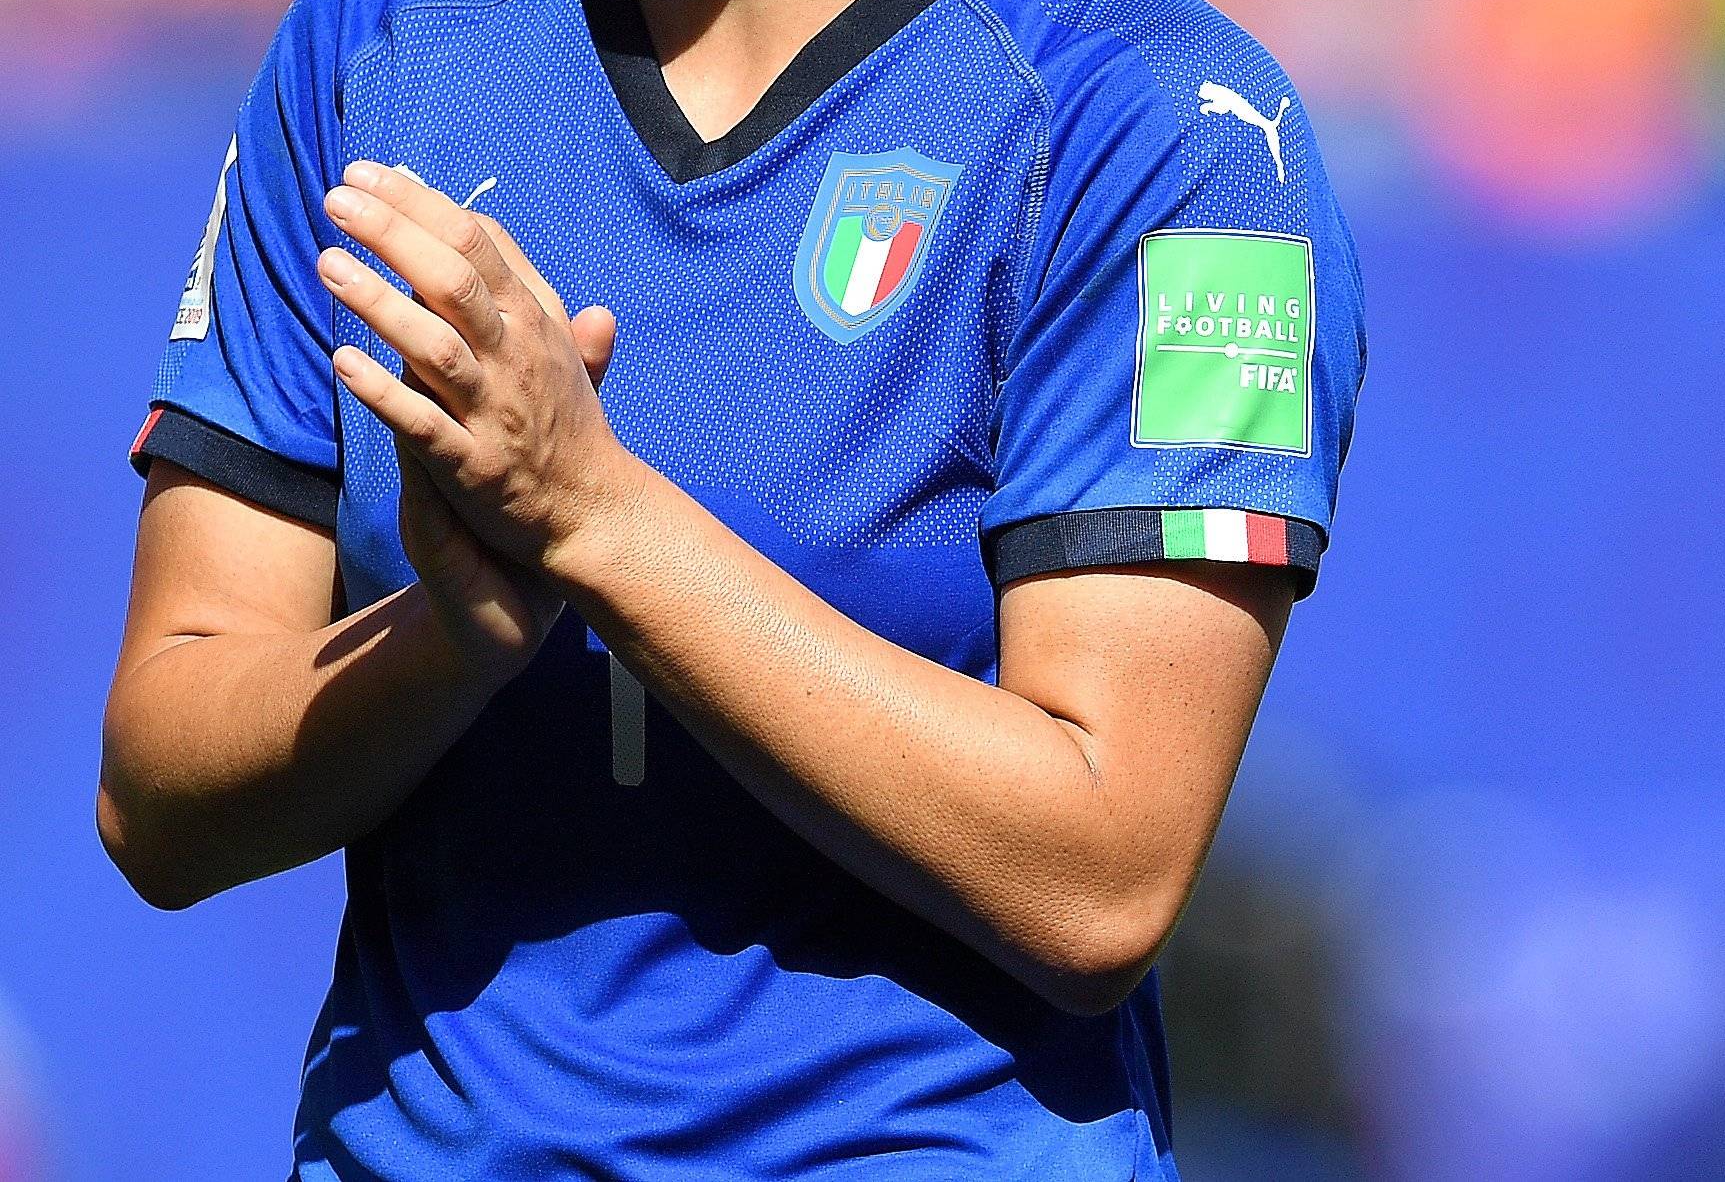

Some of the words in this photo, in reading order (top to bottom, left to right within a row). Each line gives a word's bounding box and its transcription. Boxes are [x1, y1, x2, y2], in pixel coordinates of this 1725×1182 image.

[845, 181, 936, 209] ITALIA
[1158, 291, 1300, 318] LIVING
[1156, 315, 1299, 343] FOOTBALL
[1239, 363, 1297, 394] FIFA
